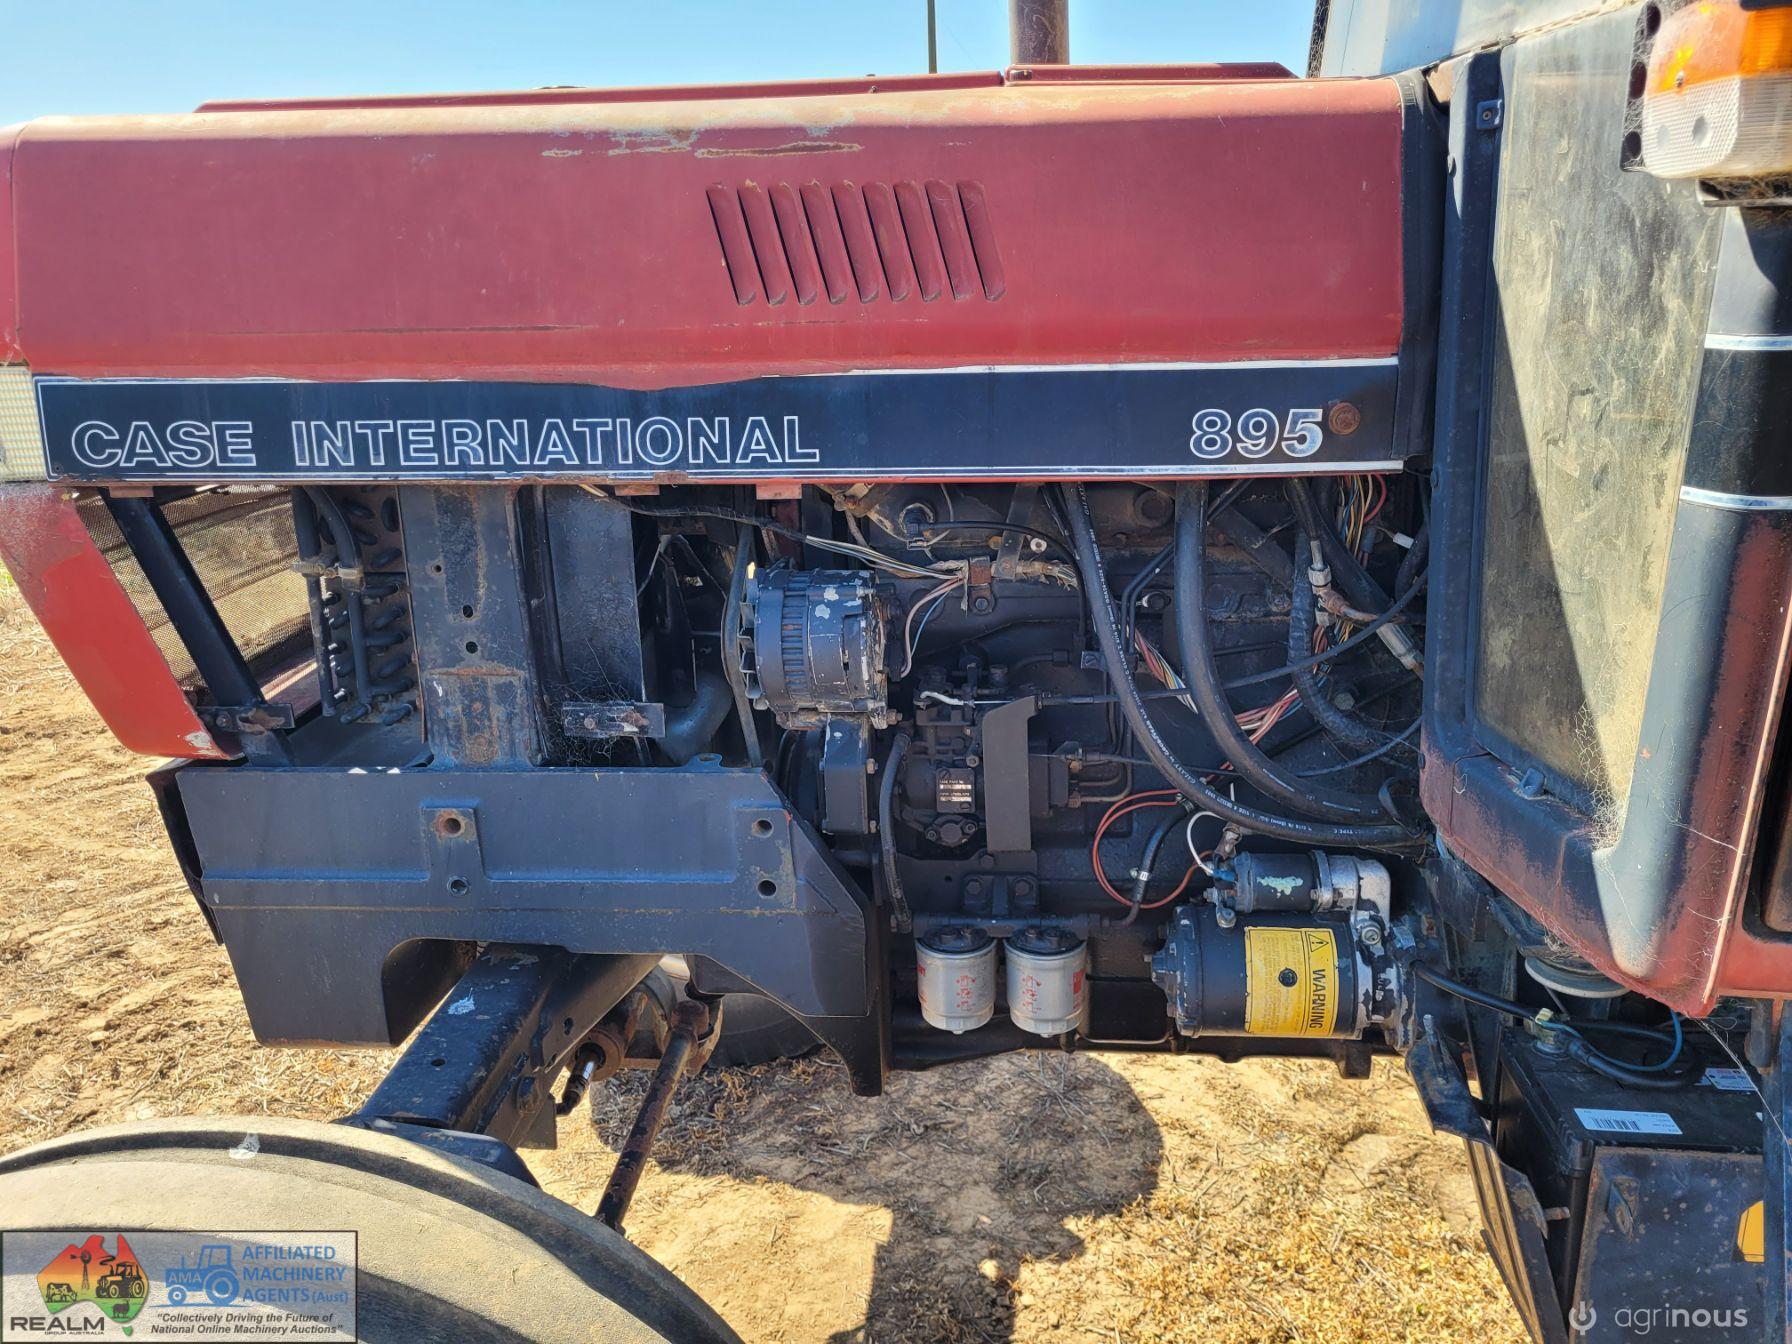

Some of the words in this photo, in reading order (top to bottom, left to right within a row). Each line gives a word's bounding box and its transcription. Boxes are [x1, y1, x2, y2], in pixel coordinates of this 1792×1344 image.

[71, 421, 256, 468] CASE
[291, 416, 819, 467] INTERNATIONAL
[1189, 408, 1324, 459] 895
[1308, 968, 1326, 1029] WARNING
